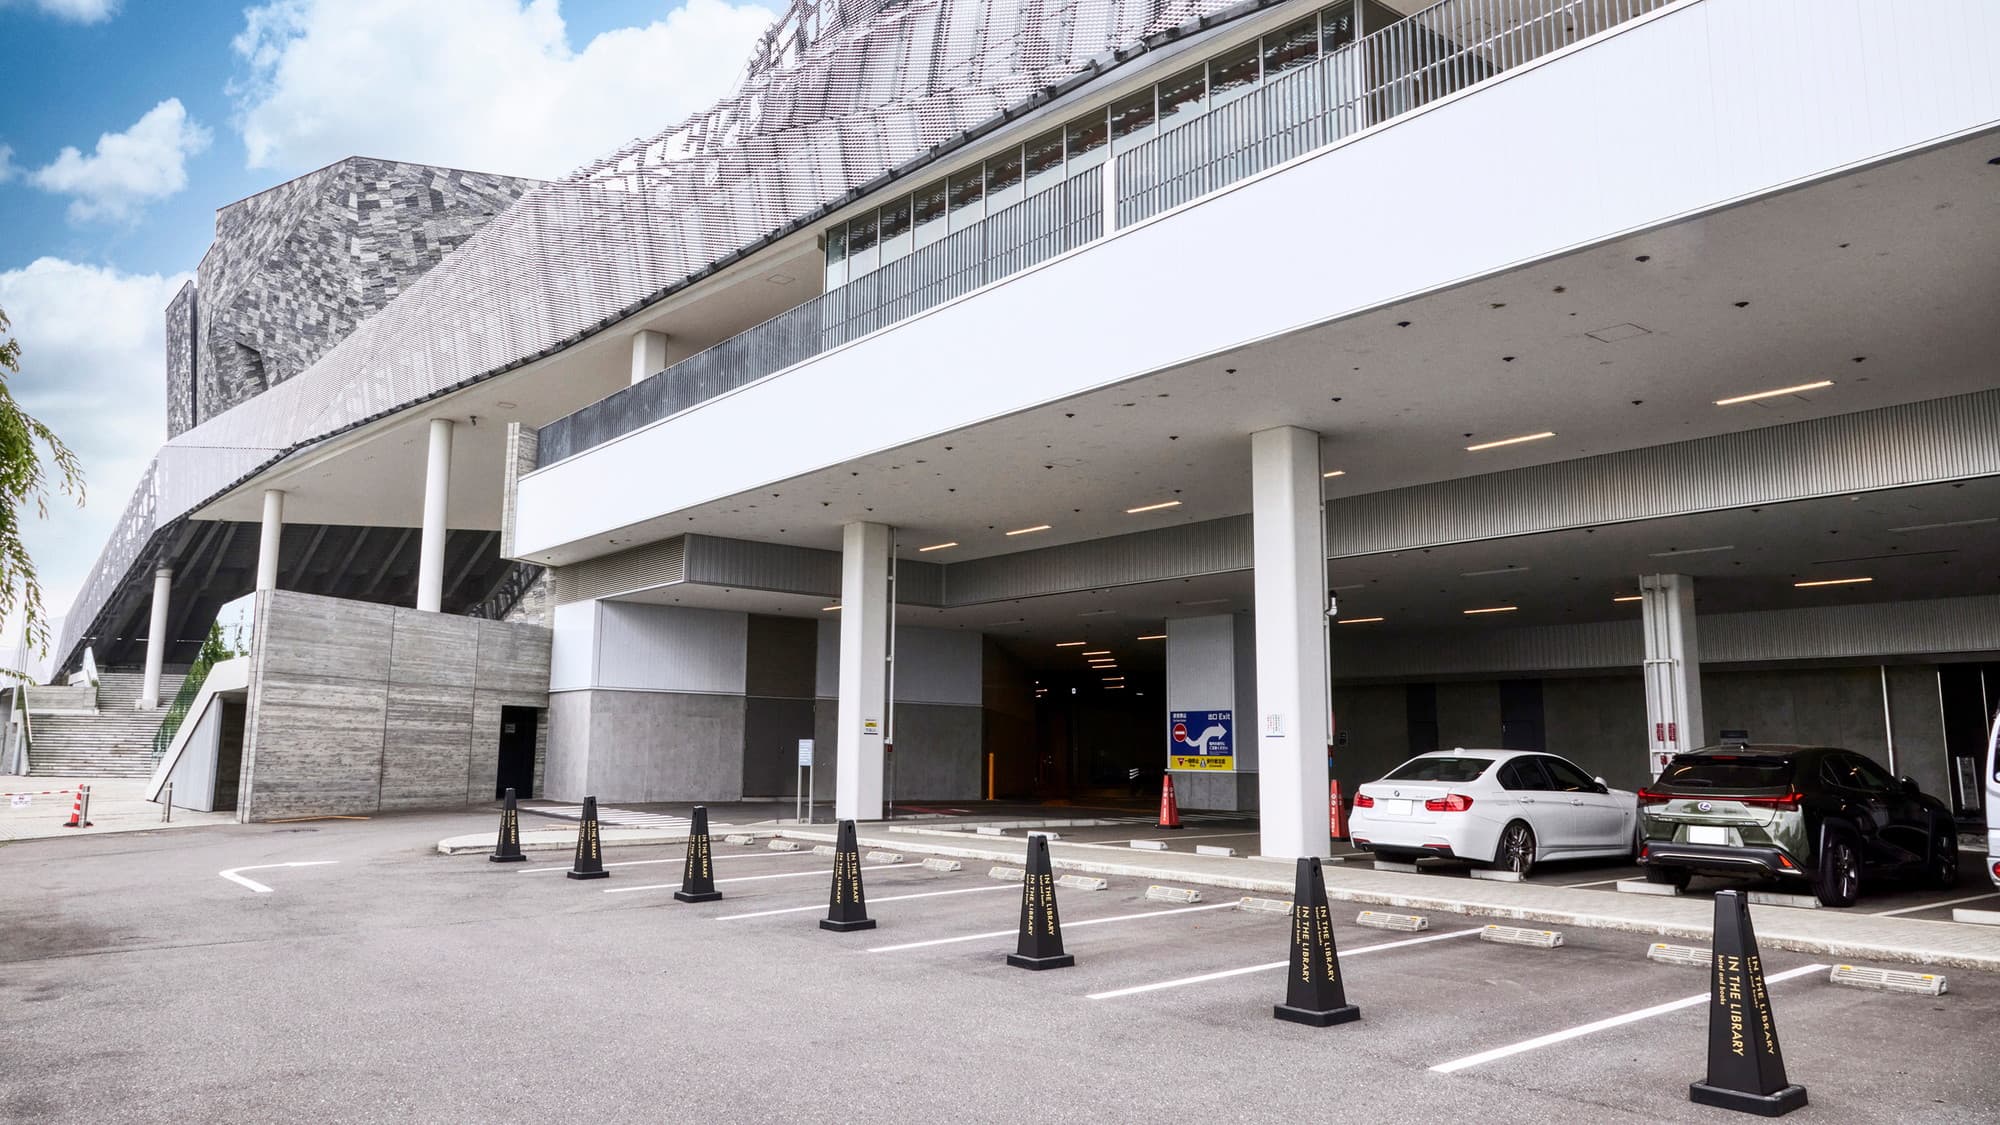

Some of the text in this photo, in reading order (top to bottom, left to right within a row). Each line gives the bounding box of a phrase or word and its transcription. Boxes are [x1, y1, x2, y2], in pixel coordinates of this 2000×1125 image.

[1218, 712, 1231, 720] Exit
[851, 852, 856, 860] IN
[1030, 874, 1035, 884] IN
[1044, 874, 1050, 884] IN
[1046, 903, 1054, 936] LIBRARY
[1302, 906, 1310, 983] IN THE LIBRARY
[1320, 906, 1327, 918] IN
[1324, 942, 1335, 982] LIBRARY
[1728, 956, 1744, 1056] IN THE LIBRARY
[1752, 956, 1775, 1055] IN THE LIBRARY
